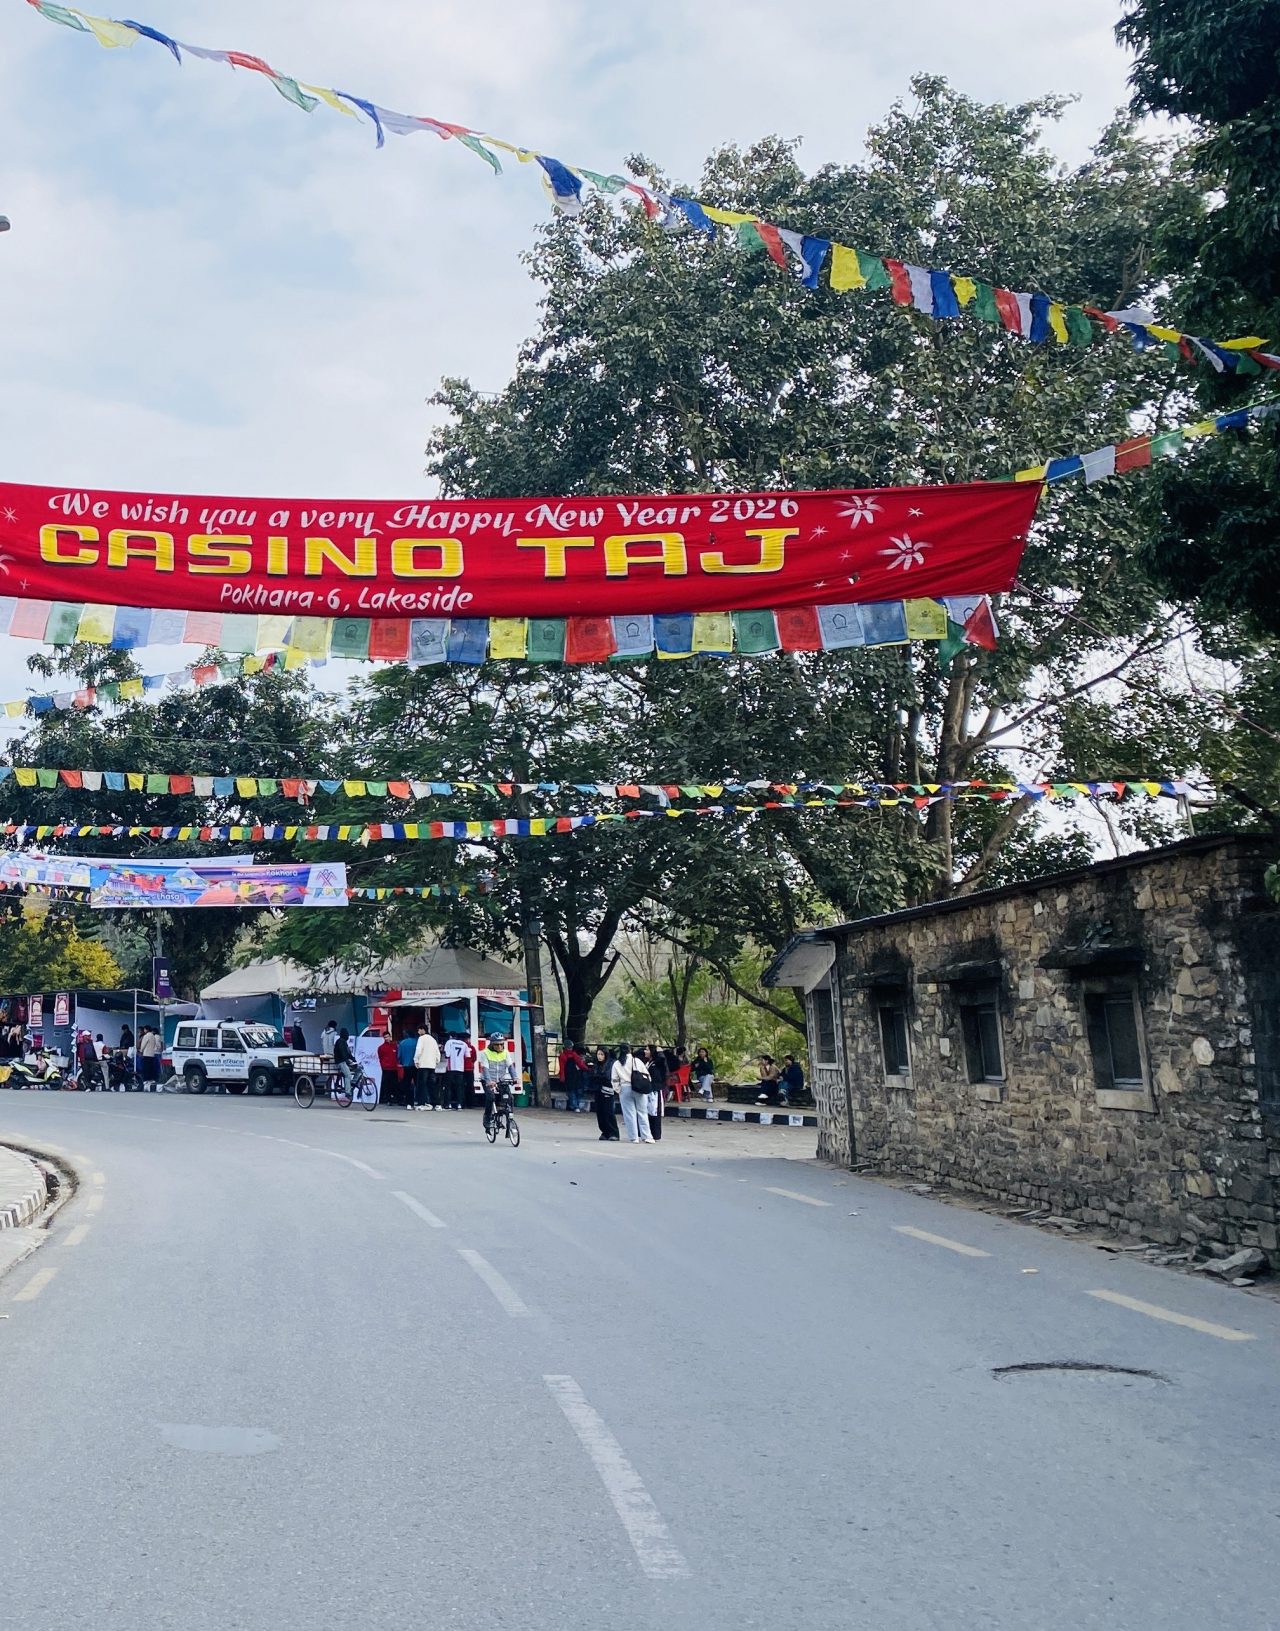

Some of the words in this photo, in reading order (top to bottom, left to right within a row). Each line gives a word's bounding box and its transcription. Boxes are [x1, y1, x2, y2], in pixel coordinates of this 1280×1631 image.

[48, 492, 110, 519] We
[121, 499, 189, 524] wish
[199, 507, 257, 535] you
[268, 510, 290, 528] a
[300, 509, 384, 537] very
[385, 505, 524, 537] Happy
[525, 502, 605, 531] New
[616, 501, 701, 527] Year
[709, 498, 800, 523] 2026
[38, 523, 464, 578] CASINO
[516, 527, 800, 579] TAJ
[357, 585, 475, 611] Lakeside
[455, 1046, 462, 1057] 7
